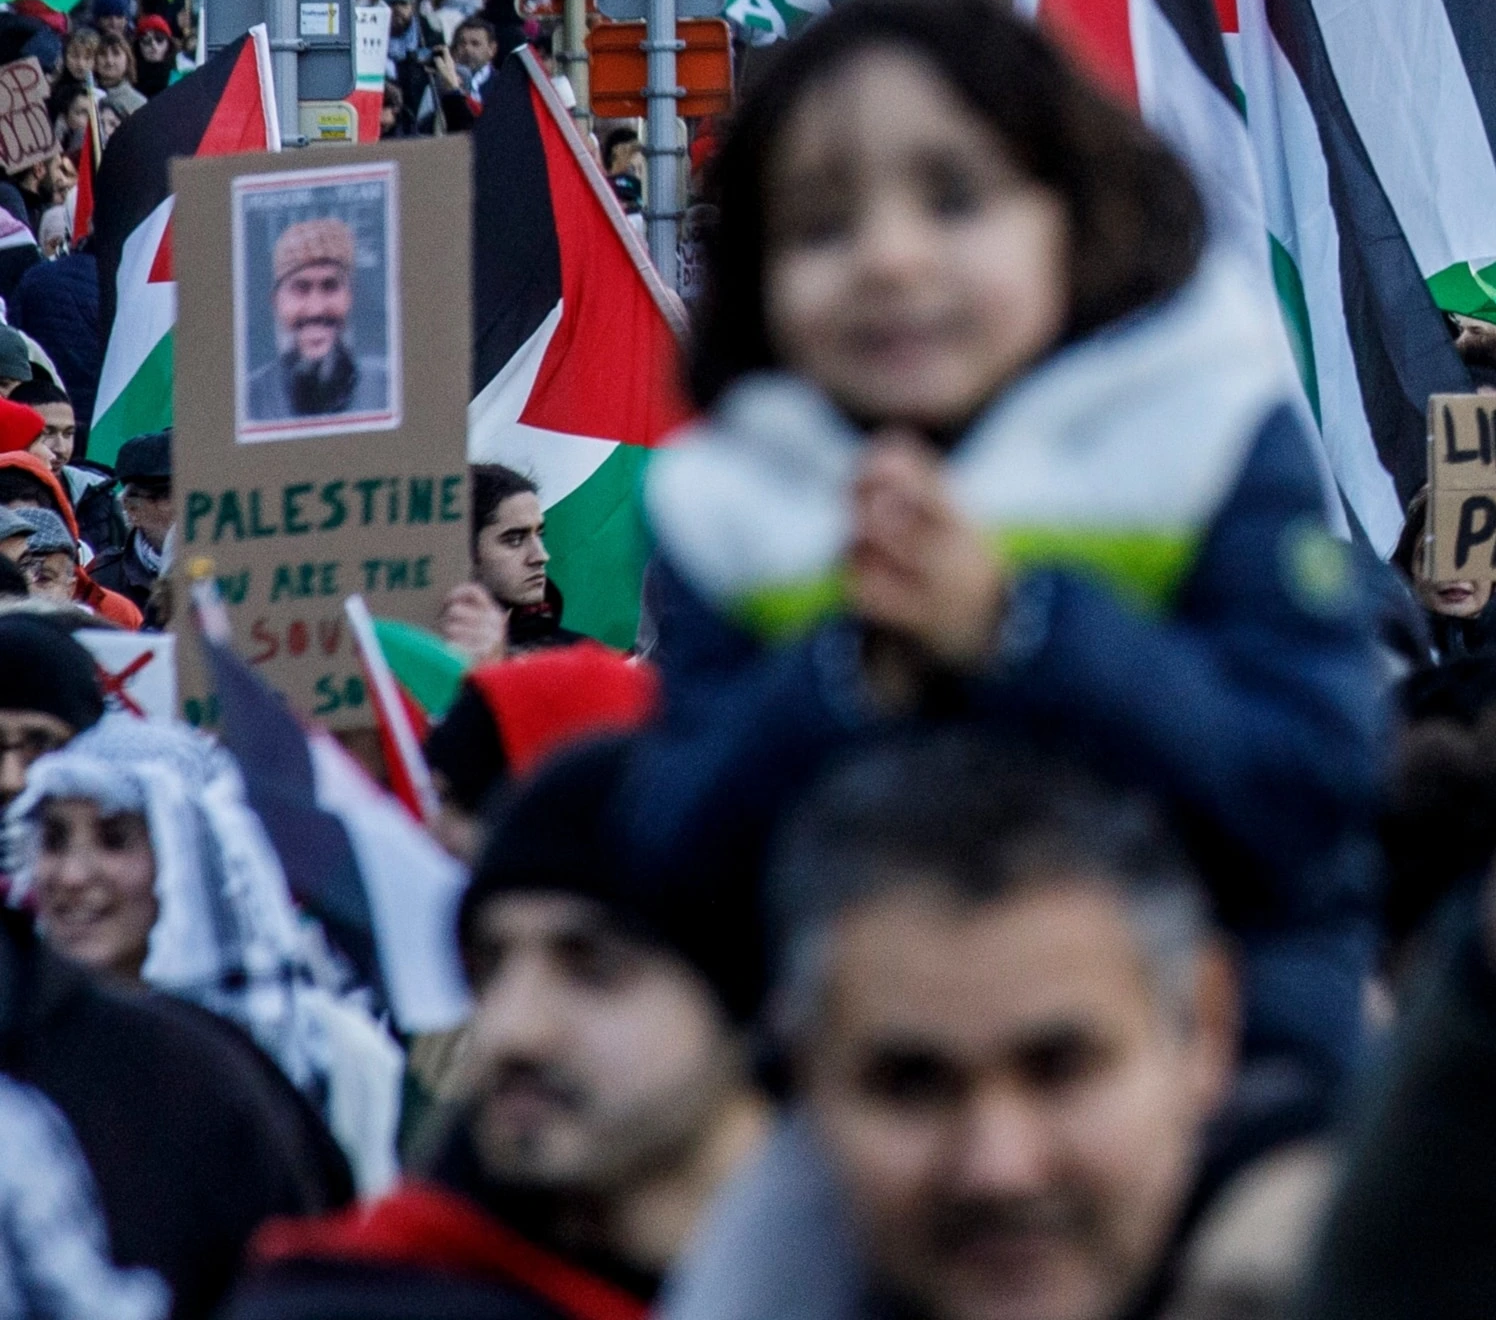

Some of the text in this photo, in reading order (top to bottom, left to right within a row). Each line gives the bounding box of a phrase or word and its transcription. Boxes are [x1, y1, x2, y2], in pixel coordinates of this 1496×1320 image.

[184, 474, 464, 543] PALESTINE
[269, 561, 339, 602] ARE
[363, 555, 433, 591] THE
[249, 617, 343, 667] SOU
